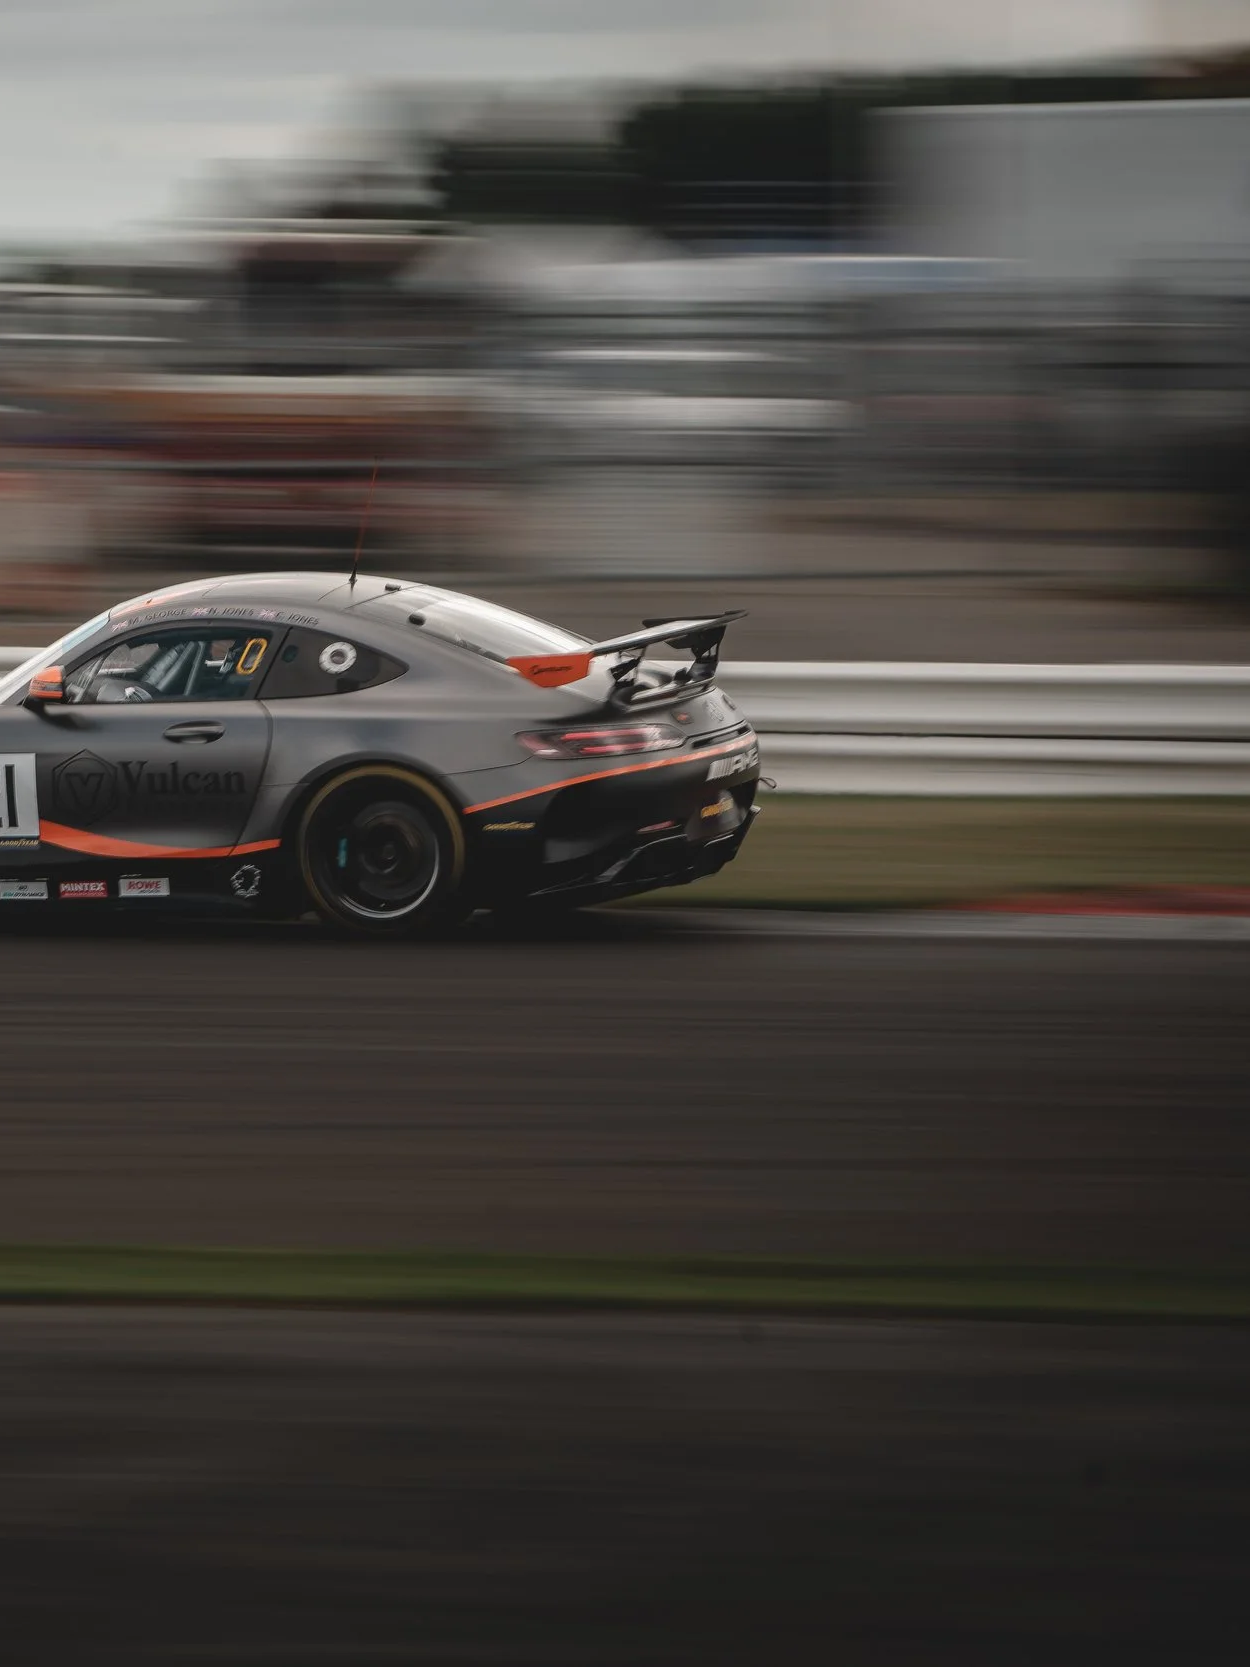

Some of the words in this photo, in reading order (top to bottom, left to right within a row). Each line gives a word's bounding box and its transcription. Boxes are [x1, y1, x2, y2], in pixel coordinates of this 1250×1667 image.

[144, 608, 188, 621] GEORGE
[222, 607, 255, 617] JONES
[288, 612, 321, 626] JONES
[117, 760, 247, 796] Vulcan
[61, 881, 105, 892] MINTEX
[127, 880, 161, 890] ROWE
